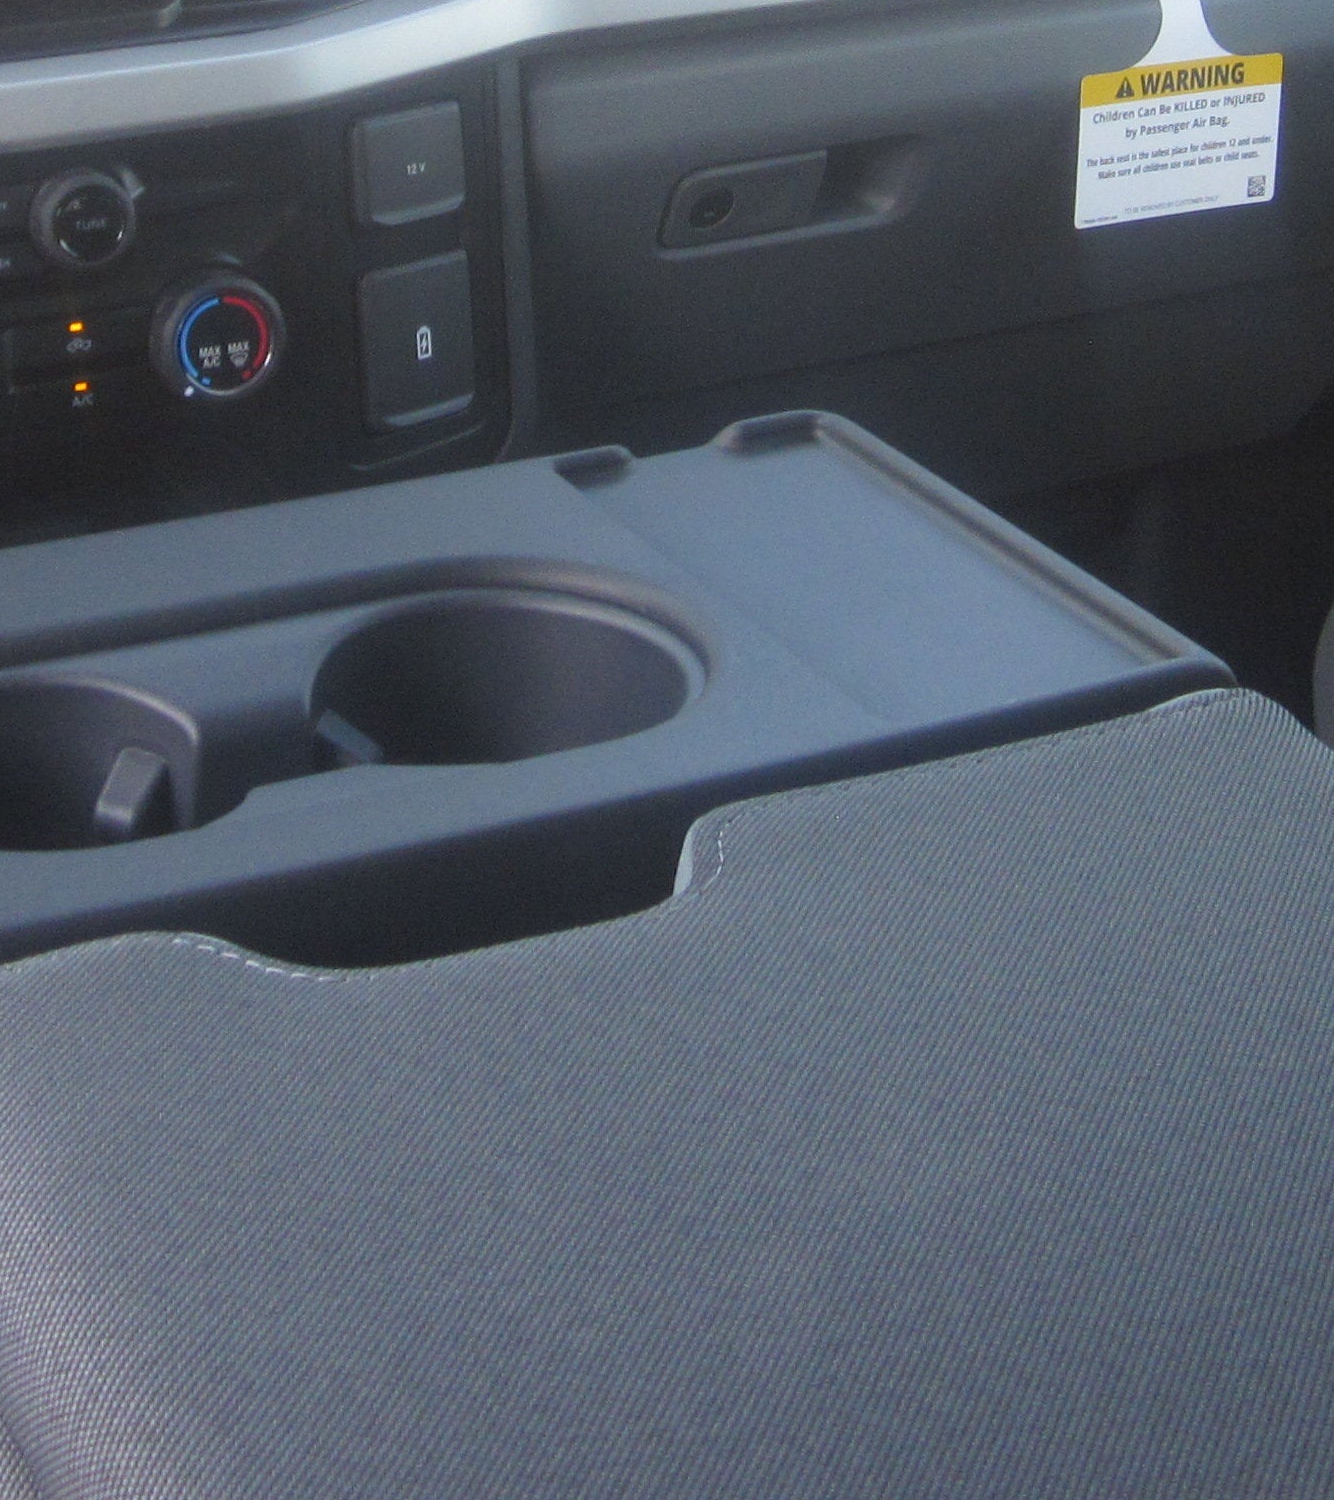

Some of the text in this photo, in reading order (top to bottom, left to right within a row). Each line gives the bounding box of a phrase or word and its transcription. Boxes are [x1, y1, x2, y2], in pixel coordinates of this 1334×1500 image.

[1141, 62, 1245, 97] WARNING
[1093, 92, 1266, 125] Children Can Be KILLED or INJURED
[1125, 115, 1231, 140] by Passenger Air Bag.
[1087, 158, 1098, 167] The
[1100, 156, 1115, 166] back
[1117, 154, 1130, 163] seat
[1139, 152, 1149, 160] the
[1151, 148, 1170, 158] safest
[1171, 145, 1188, 156] place
[1190, 143, 1199, 153] for
[1201, 141, 1227, 151] children
[1229, 139, 1236, 147] 12
[1238, 138, 1250, 147] and
[1097, 171, 1116, 180] Make
[1117, 169, 1132, 177] sure
[1133, 165, 1141, 176] all
[1143, 162, 1169, 173] children
[1170, 161, 1181, 170] use
[1183, 159, 1196, 167] seat
[1198, 156, 1213, 165] belts
[1224, 152, 1239, 162] child
[199, 345, 222, 358] MAX
[227, 340, 250, 353] MAX
[203, 356, 221, 368] A/C
[72, 393, 94, 408] A/C
